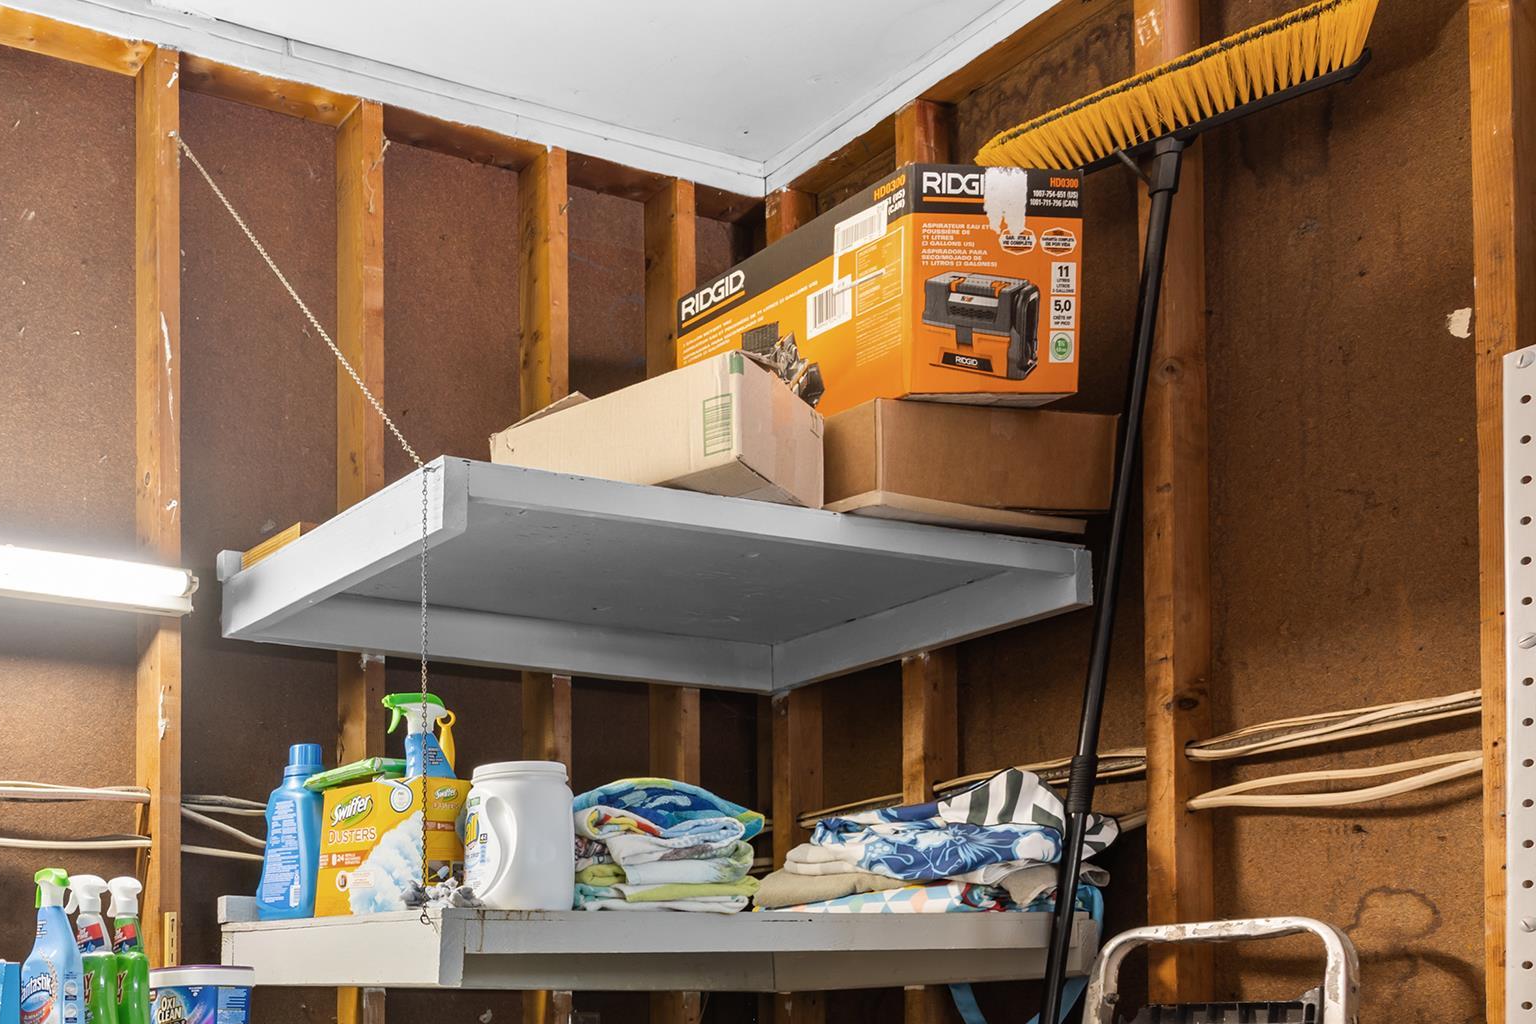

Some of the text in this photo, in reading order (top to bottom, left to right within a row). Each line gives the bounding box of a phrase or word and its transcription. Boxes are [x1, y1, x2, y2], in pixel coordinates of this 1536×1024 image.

[873, 175, 906, 201] HD0300
[923, 171, 985, 195] RIDGI
[1050, 177, 1078, 188] HD0300
[1057, 265, 1069, 277] 11
[681, 269, 746, 321] RIDGID
[1054, 300, 1071, 313] 5,0
[331, 795, 371, 827] Swiffer
[328, 827, 377, 844] DUSTERS
[21, 972, 52, 1002] antastik
[161, 996, 177, 1011] OXI
[157, 1006, 182, 1023] CLEAN
